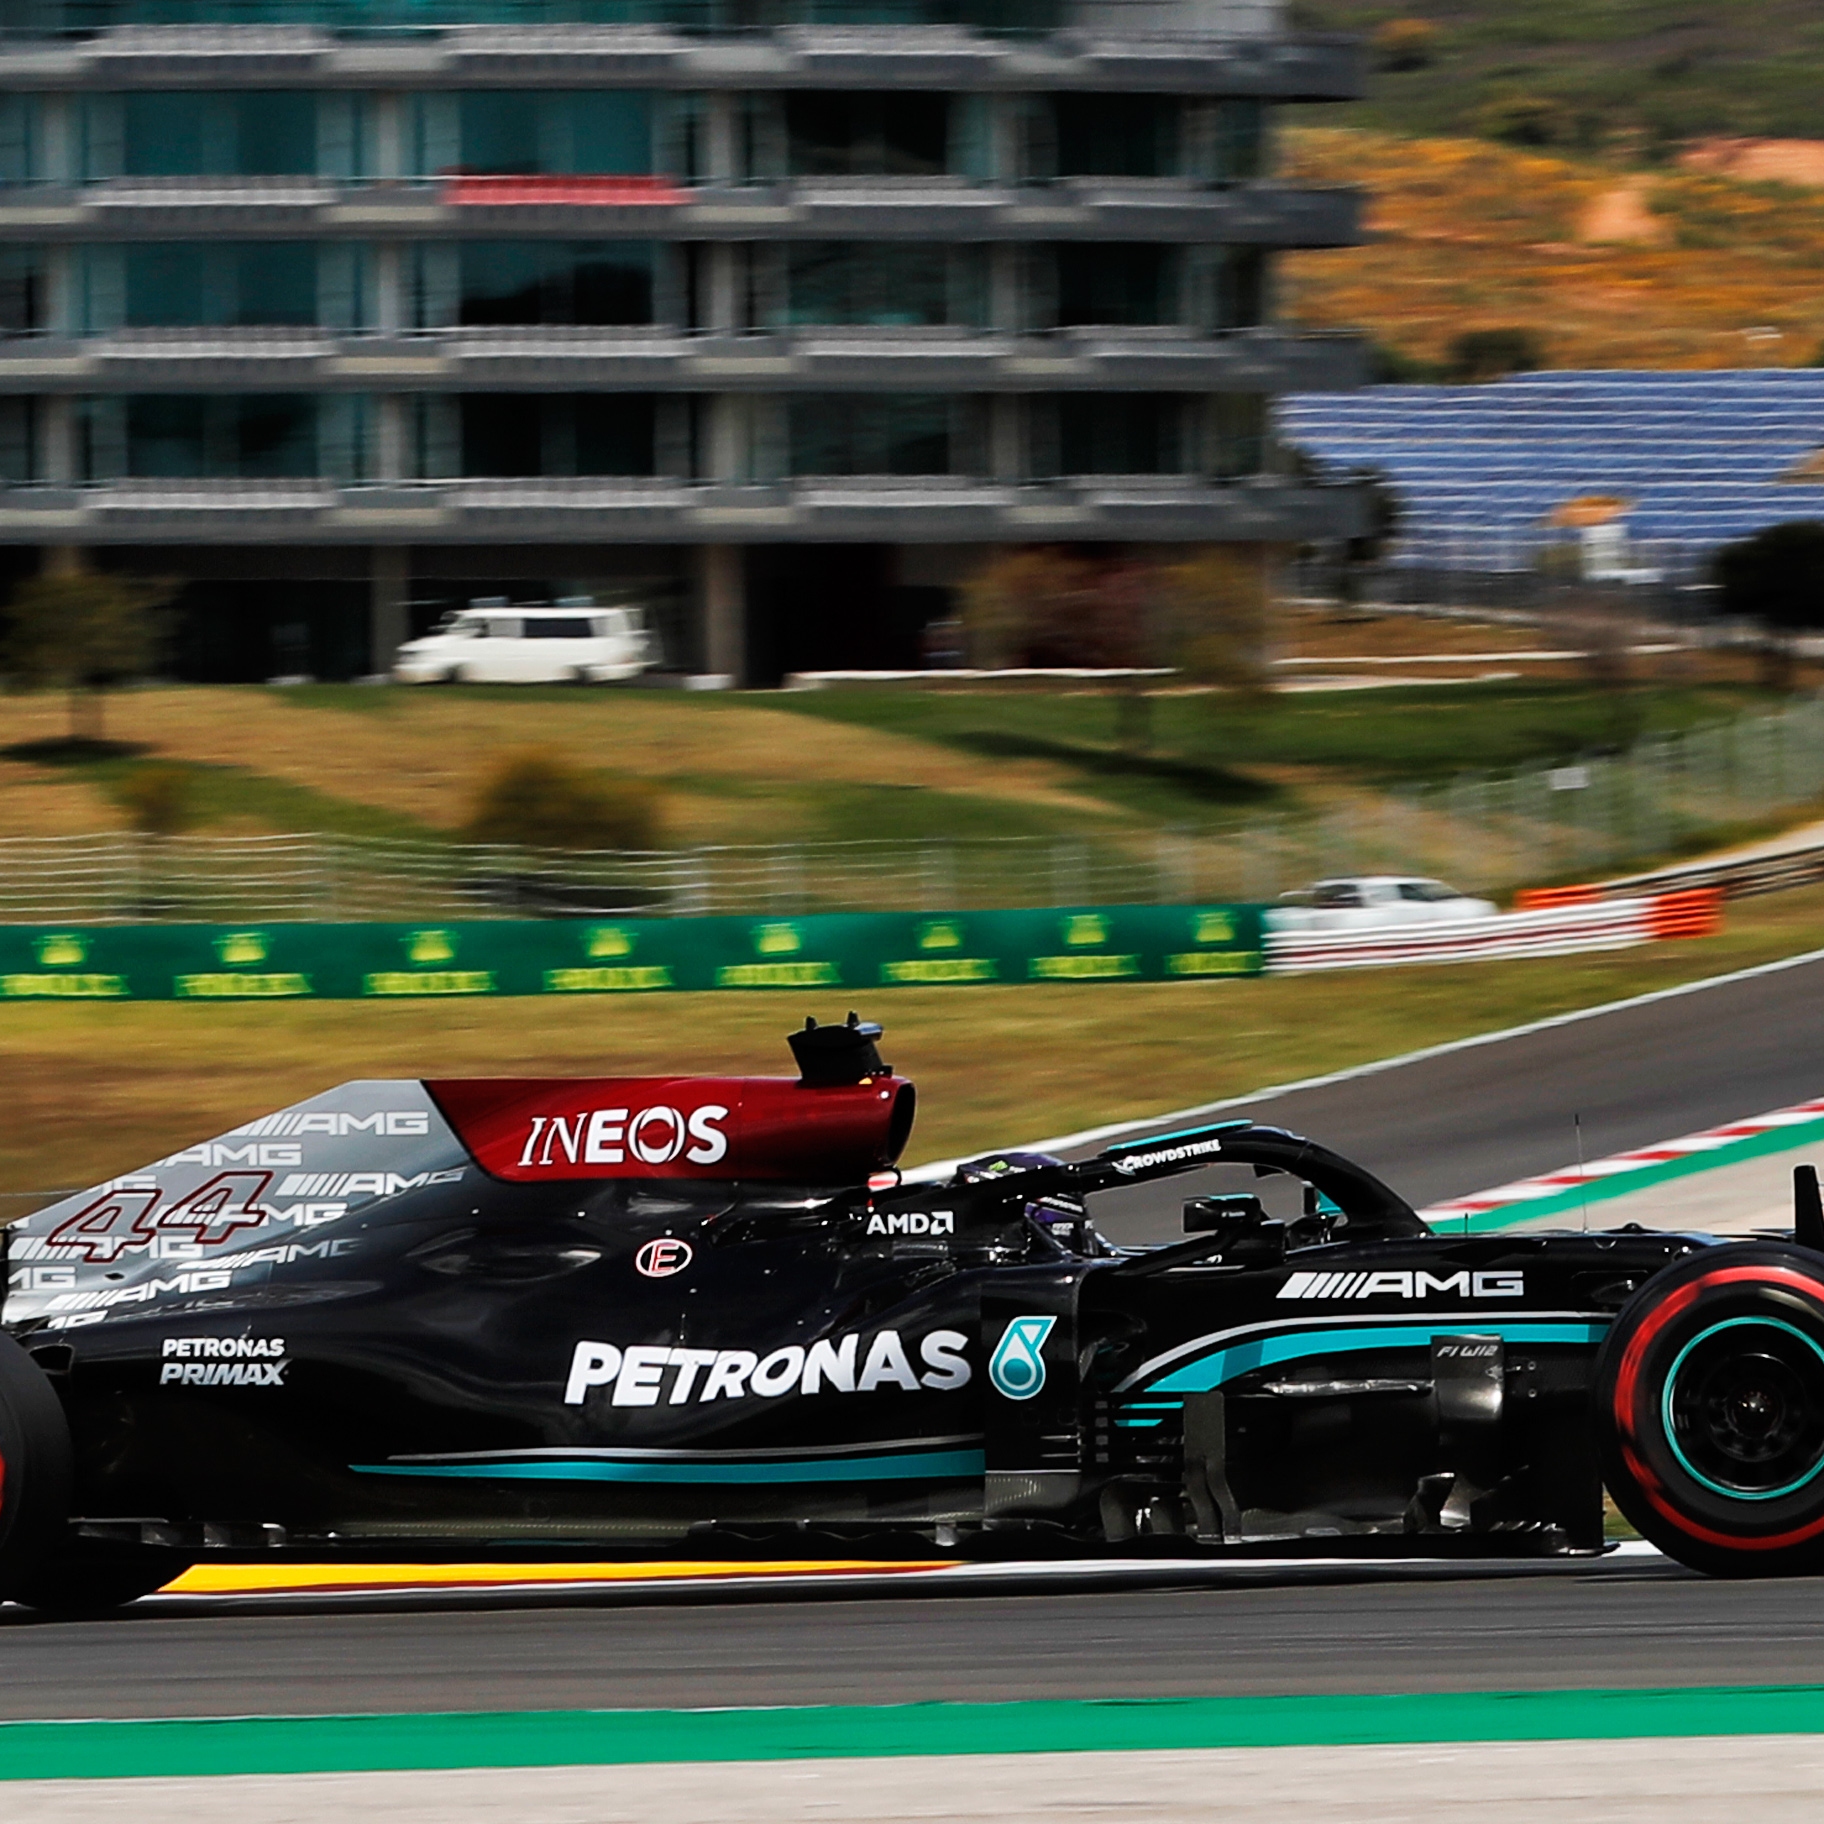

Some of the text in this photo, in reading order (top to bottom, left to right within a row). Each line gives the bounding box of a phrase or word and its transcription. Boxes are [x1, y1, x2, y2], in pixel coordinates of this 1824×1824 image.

[291, 1112, 429, 1137] AMG
[517, 1105, 729, 1166] INEOS
[164, 1143, 302, 1167] AMG
[1122, 1139, 1222, 1173] CROWDSTRIKE
[336, 1166, 468, 1197] AMG
[46, 1171, 274, 1263] 44
[866, 1213, 930, 1236] AMD
[108, 1270, 233, 1308] AMG
[1355, 1271, 1524, 1298] AMG
[162, 1337, 286, 1358] PETRONAS
[159, 1358, 293, 1386] PRIMAX
[564, 1330, 973, 1407] PETRONAS
